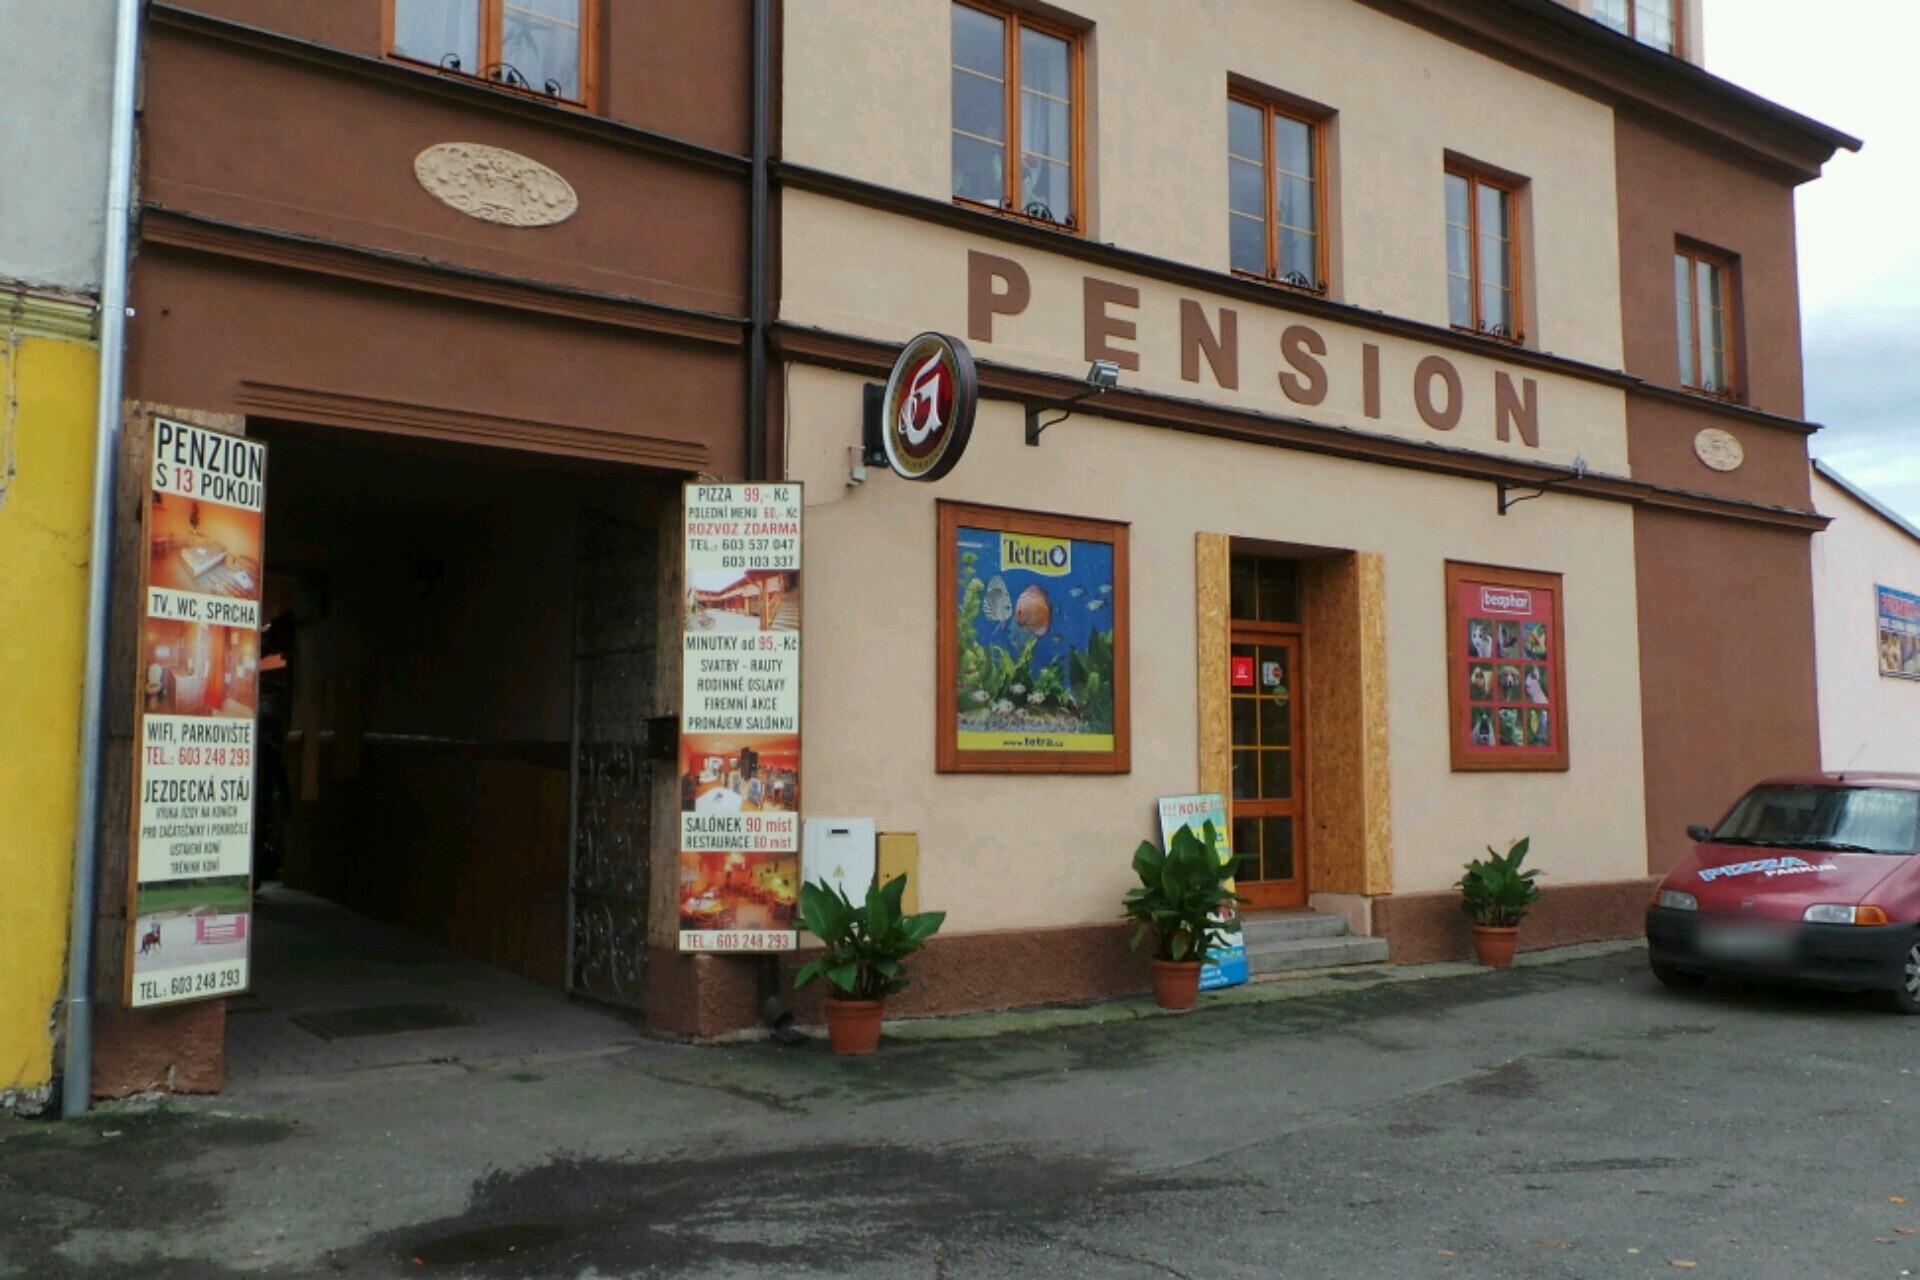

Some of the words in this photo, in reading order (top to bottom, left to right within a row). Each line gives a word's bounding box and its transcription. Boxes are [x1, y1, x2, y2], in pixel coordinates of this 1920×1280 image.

[967, 249, 1540, 448] PENSION
[156, 422, 263, 482] PENZION
[156, 463, 168, 488] S
[175, 467, 194, 493] 13
[201, 474, 261, 508] POKOJI
[697, 487, 732, 502] PIZZA
[774, 487, 789, 501] Kč
[688, 505, 728, 519] POLEDNÍ
[731, 507, 758, 519] MENU
[688, 523, 739, 536] ROZVOZ
[744, 523, 799, 536] ZDARMA
[722, 539, 745, 551] 603
[748, 539, 769, 551] 537
[772, 539, 795, 551] 047
[1003, 539, 1048, 567] Tetra
[722, 556, 745, 568] 603
[749, 556, 769, 568] 103
[773, 556, 795, 568] 337
[1484, 590, 1529, 609] beaphar
[207, 601, 256, 624] SPRCHA
[686, 635, 738, 651] MINUTKY
[741, 636, 755, 651] od
[783, 635, 798, 651] Kč
[700, 659, 740, 672] SVATBY
[750, 659, 783, 672] RAUTY
[697, 676, 744, 692] RODINNÉ
[748, 678, 786, 692] OSLAVY
[704, 695, 748, 711] FIREMNÍ
[751, 697, 778, 711] AKCE
[688, 714, 742, 730] PRONÁJEM
[147, 721, 177, 744] WIFI,
[179, 747, 200, 765] 603
[205, 748, 226, 765] 248
[230, 748, 251, 766] 293
[144, 775, 216, 803] JEZDECKÁ
[221, 774, 250, 801] STÁJ
[686, 813, 742, 833] SALÓNEK
[746, 817, 762, 833] 90
[686, 835, 750, 849] RESTAURACE
[1698, 856, 1809, 881] PIZZA
[716, 934, 739, 949] 603
[742, 934, 764, 949] 248
[767, 934, 790, 949] 293
[171, 975, 192, 995] 603
[195, 972, 217, 991] 248
[220, 968, 241, 987] 293
